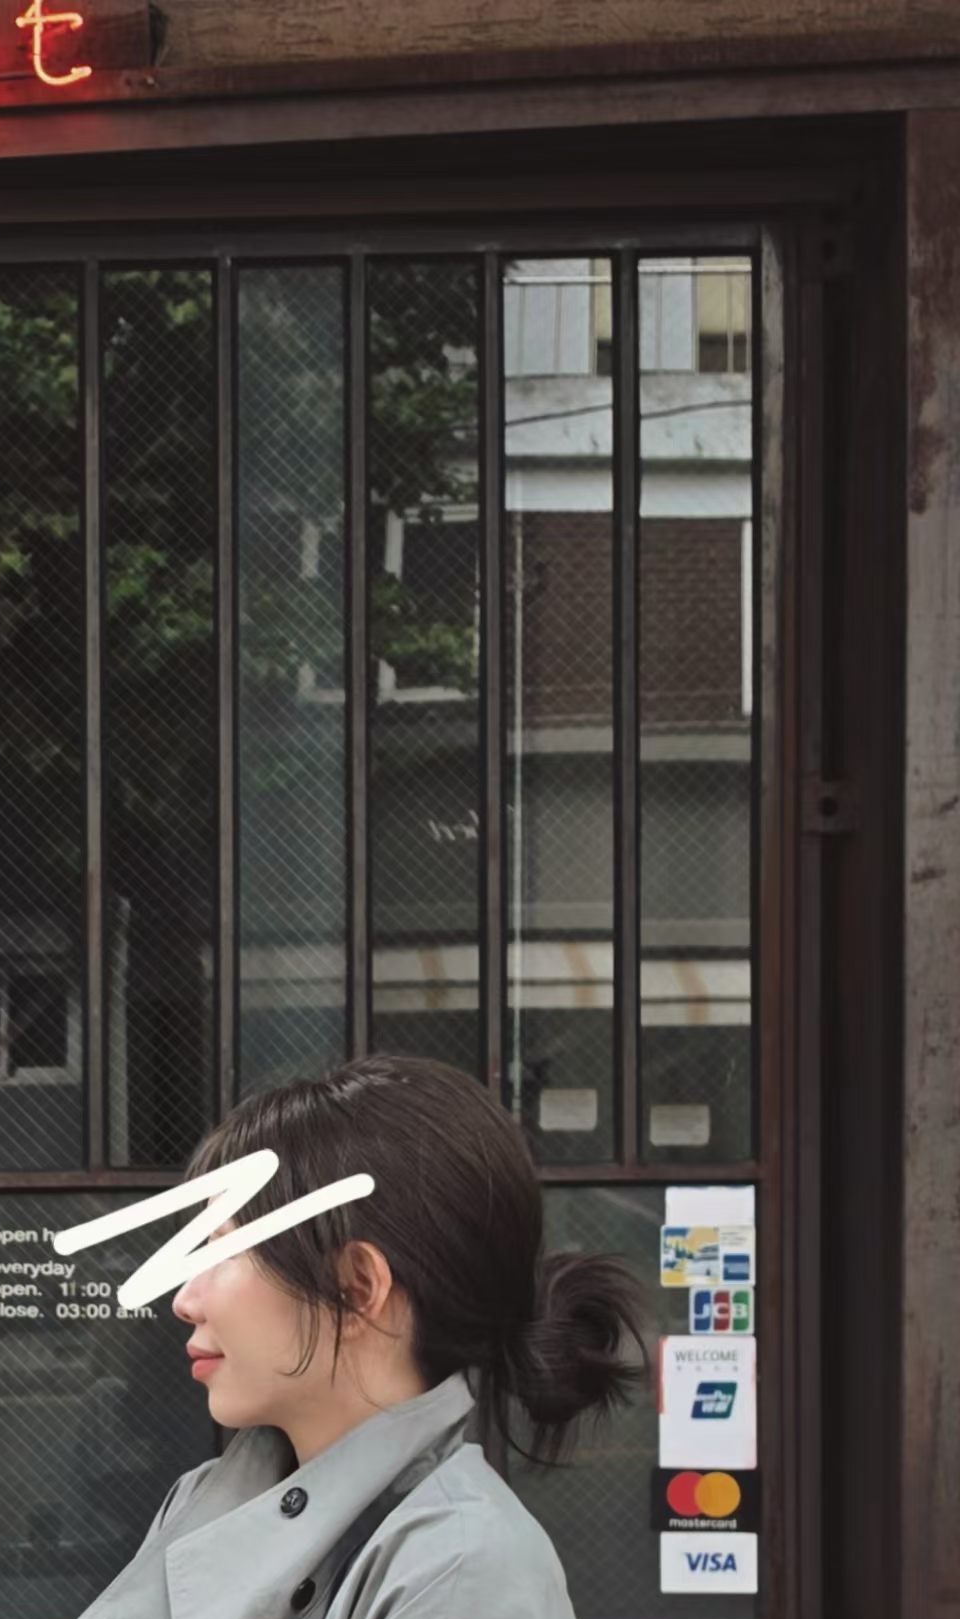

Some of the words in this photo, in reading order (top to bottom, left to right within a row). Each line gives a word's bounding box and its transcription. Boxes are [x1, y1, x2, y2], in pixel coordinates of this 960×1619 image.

[56, 1303, 111, 1319] 03:00
[675, 1349, 738, 1362] WELCOME
[668, 1518, 738, 1530] mastercard
[685, 1553, 738, 1573] VISA
